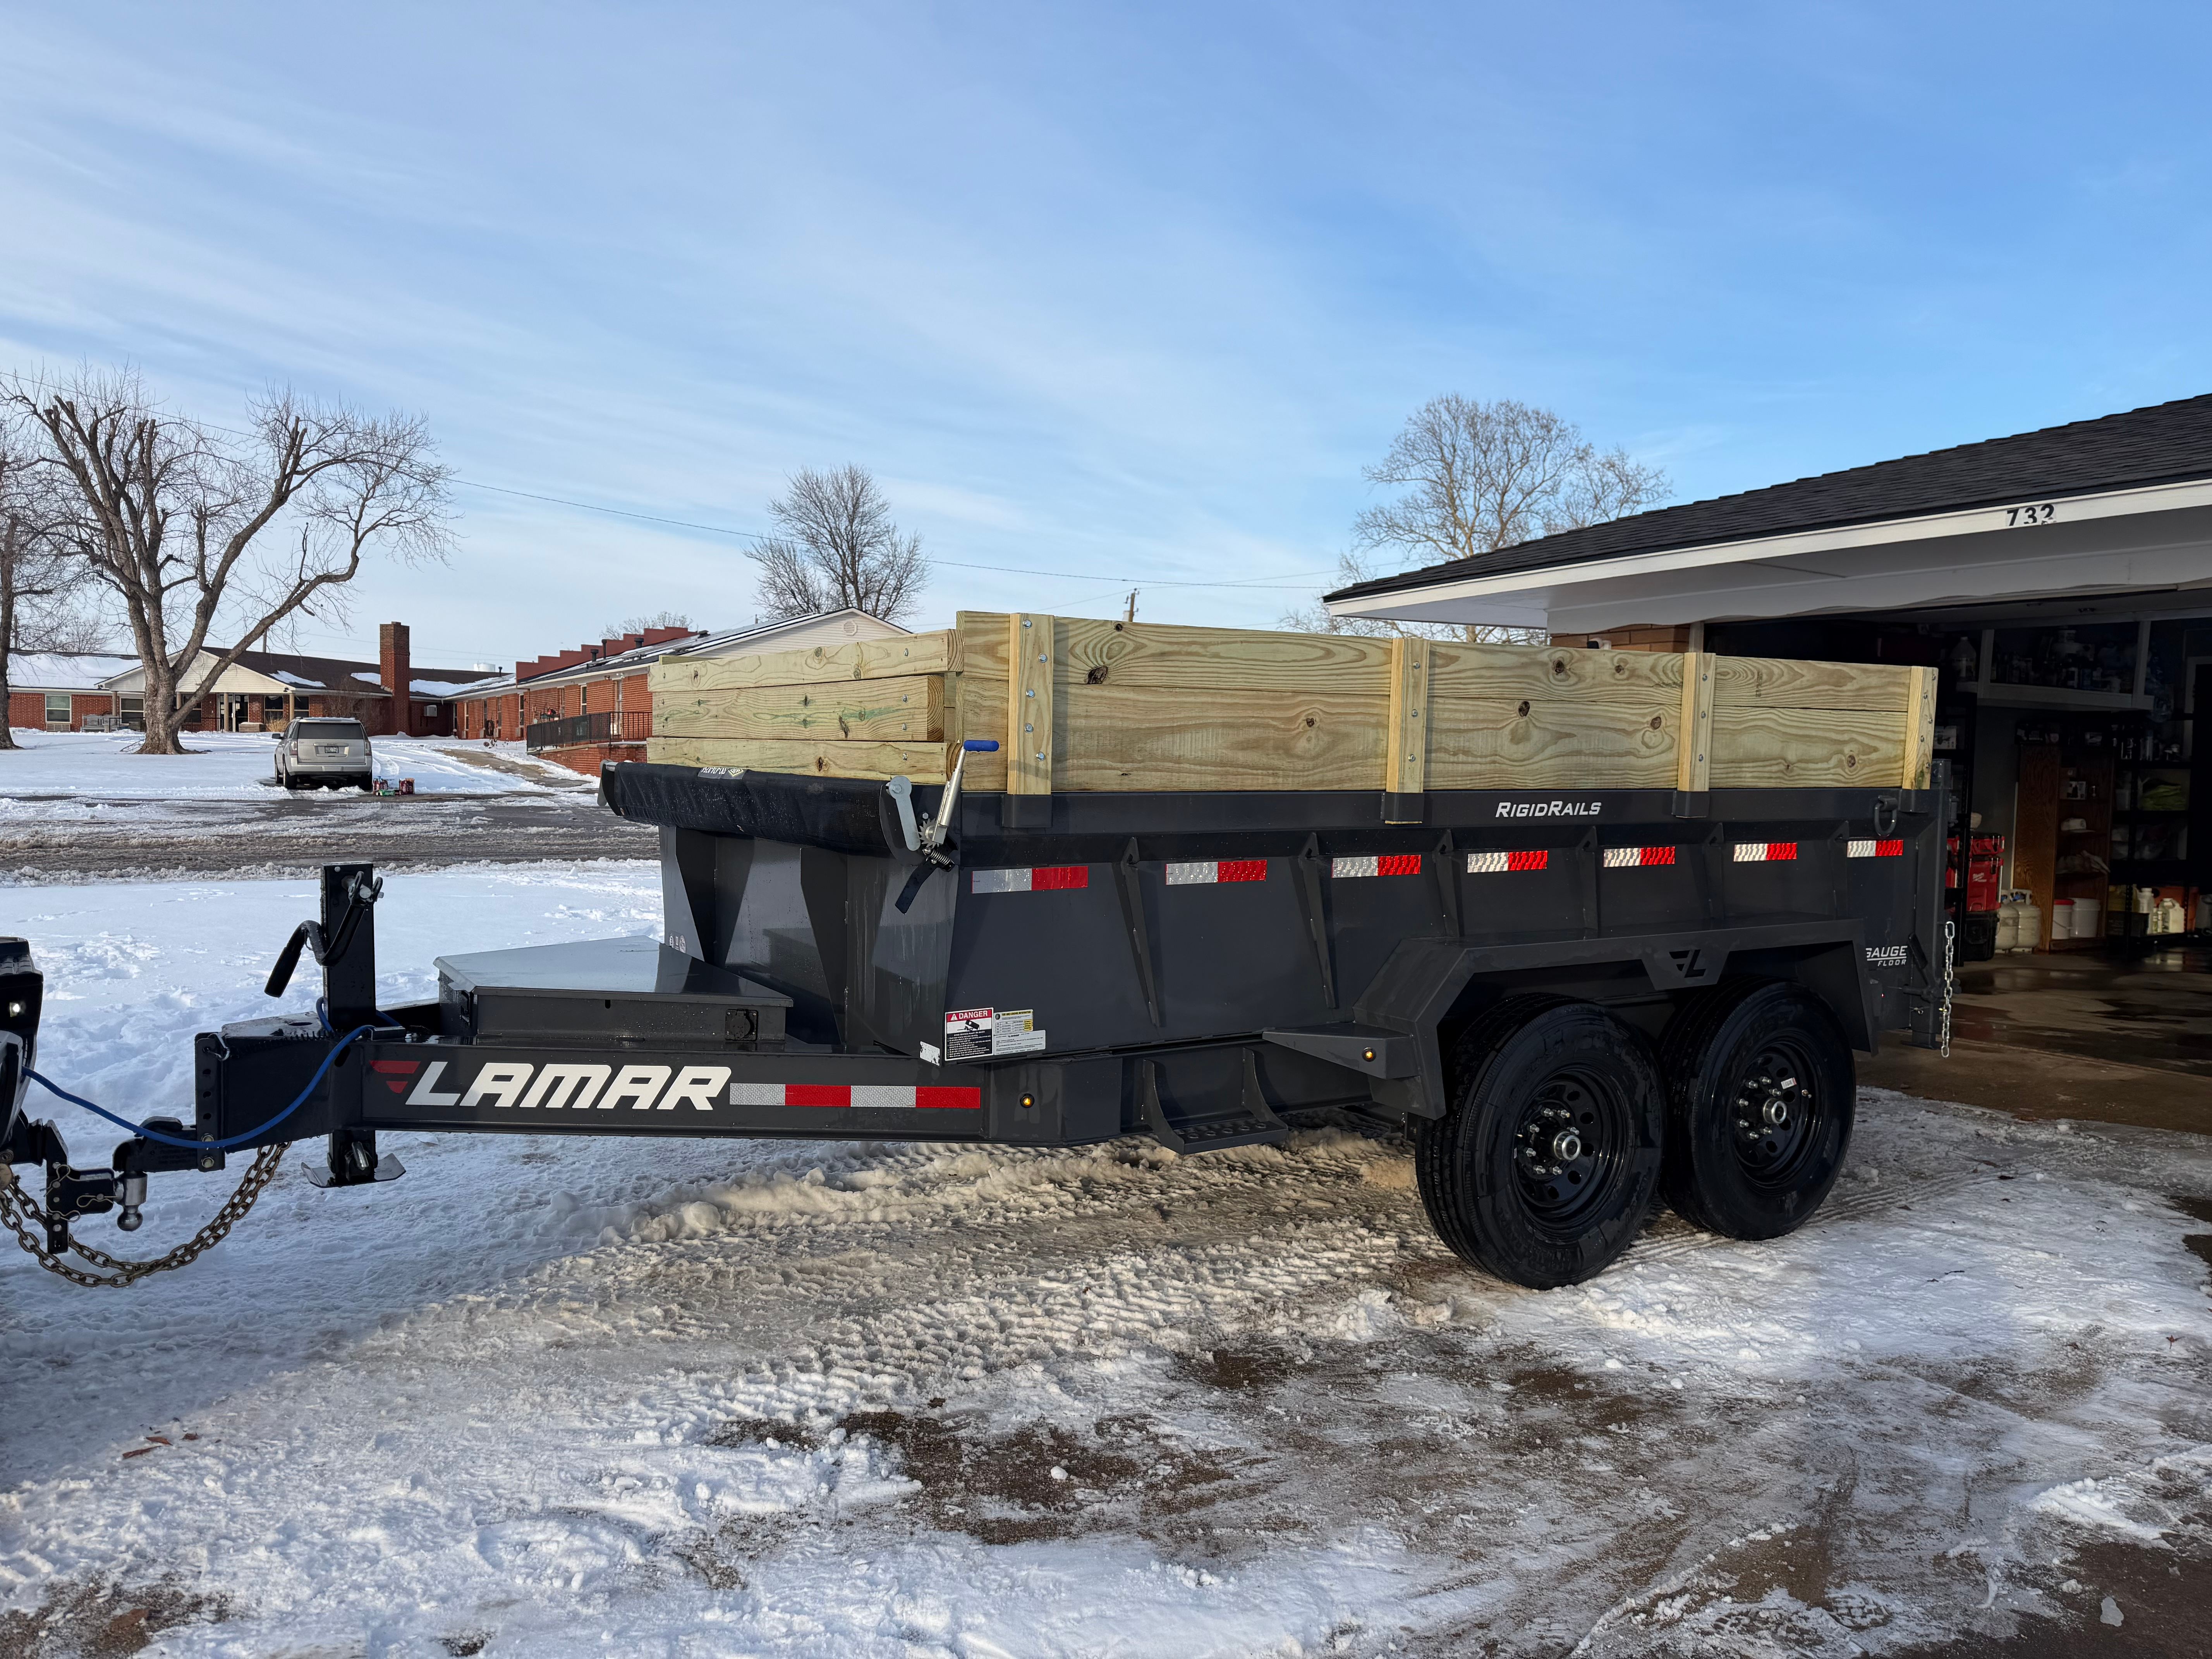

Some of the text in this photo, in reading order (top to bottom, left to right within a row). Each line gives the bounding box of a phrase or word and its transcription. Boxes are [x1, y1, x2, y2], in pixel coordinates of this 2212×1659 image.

[2007, 504, 2056, 526] 732
[959, 1010, 988, 1019] DANGER
[405, 1061, 732, 1110] LAMAR
